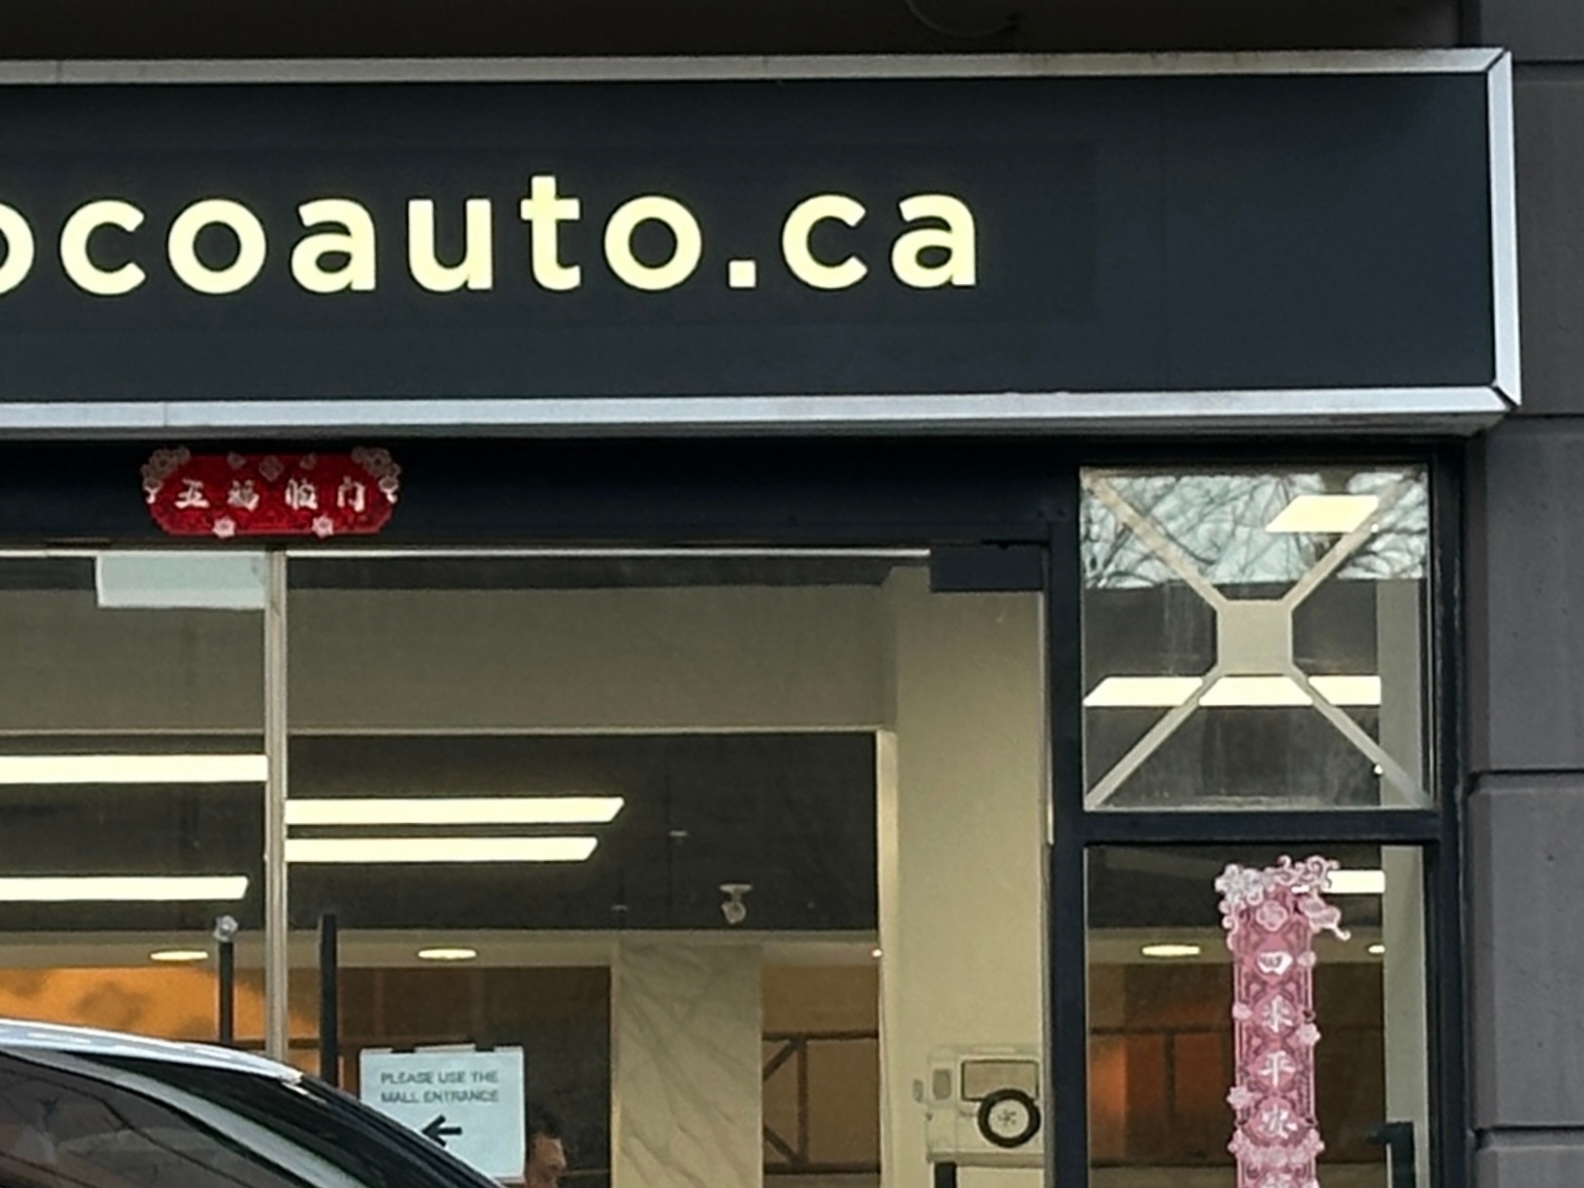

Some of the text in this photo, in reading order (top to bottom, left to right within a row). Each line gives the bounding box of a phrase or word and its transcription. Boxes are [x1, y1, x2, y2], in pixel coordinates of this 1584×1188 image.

[380, 1070, 499, 1085] PLEASE USE THE
[424, 1089, 499, 1103] ENTRANCE
